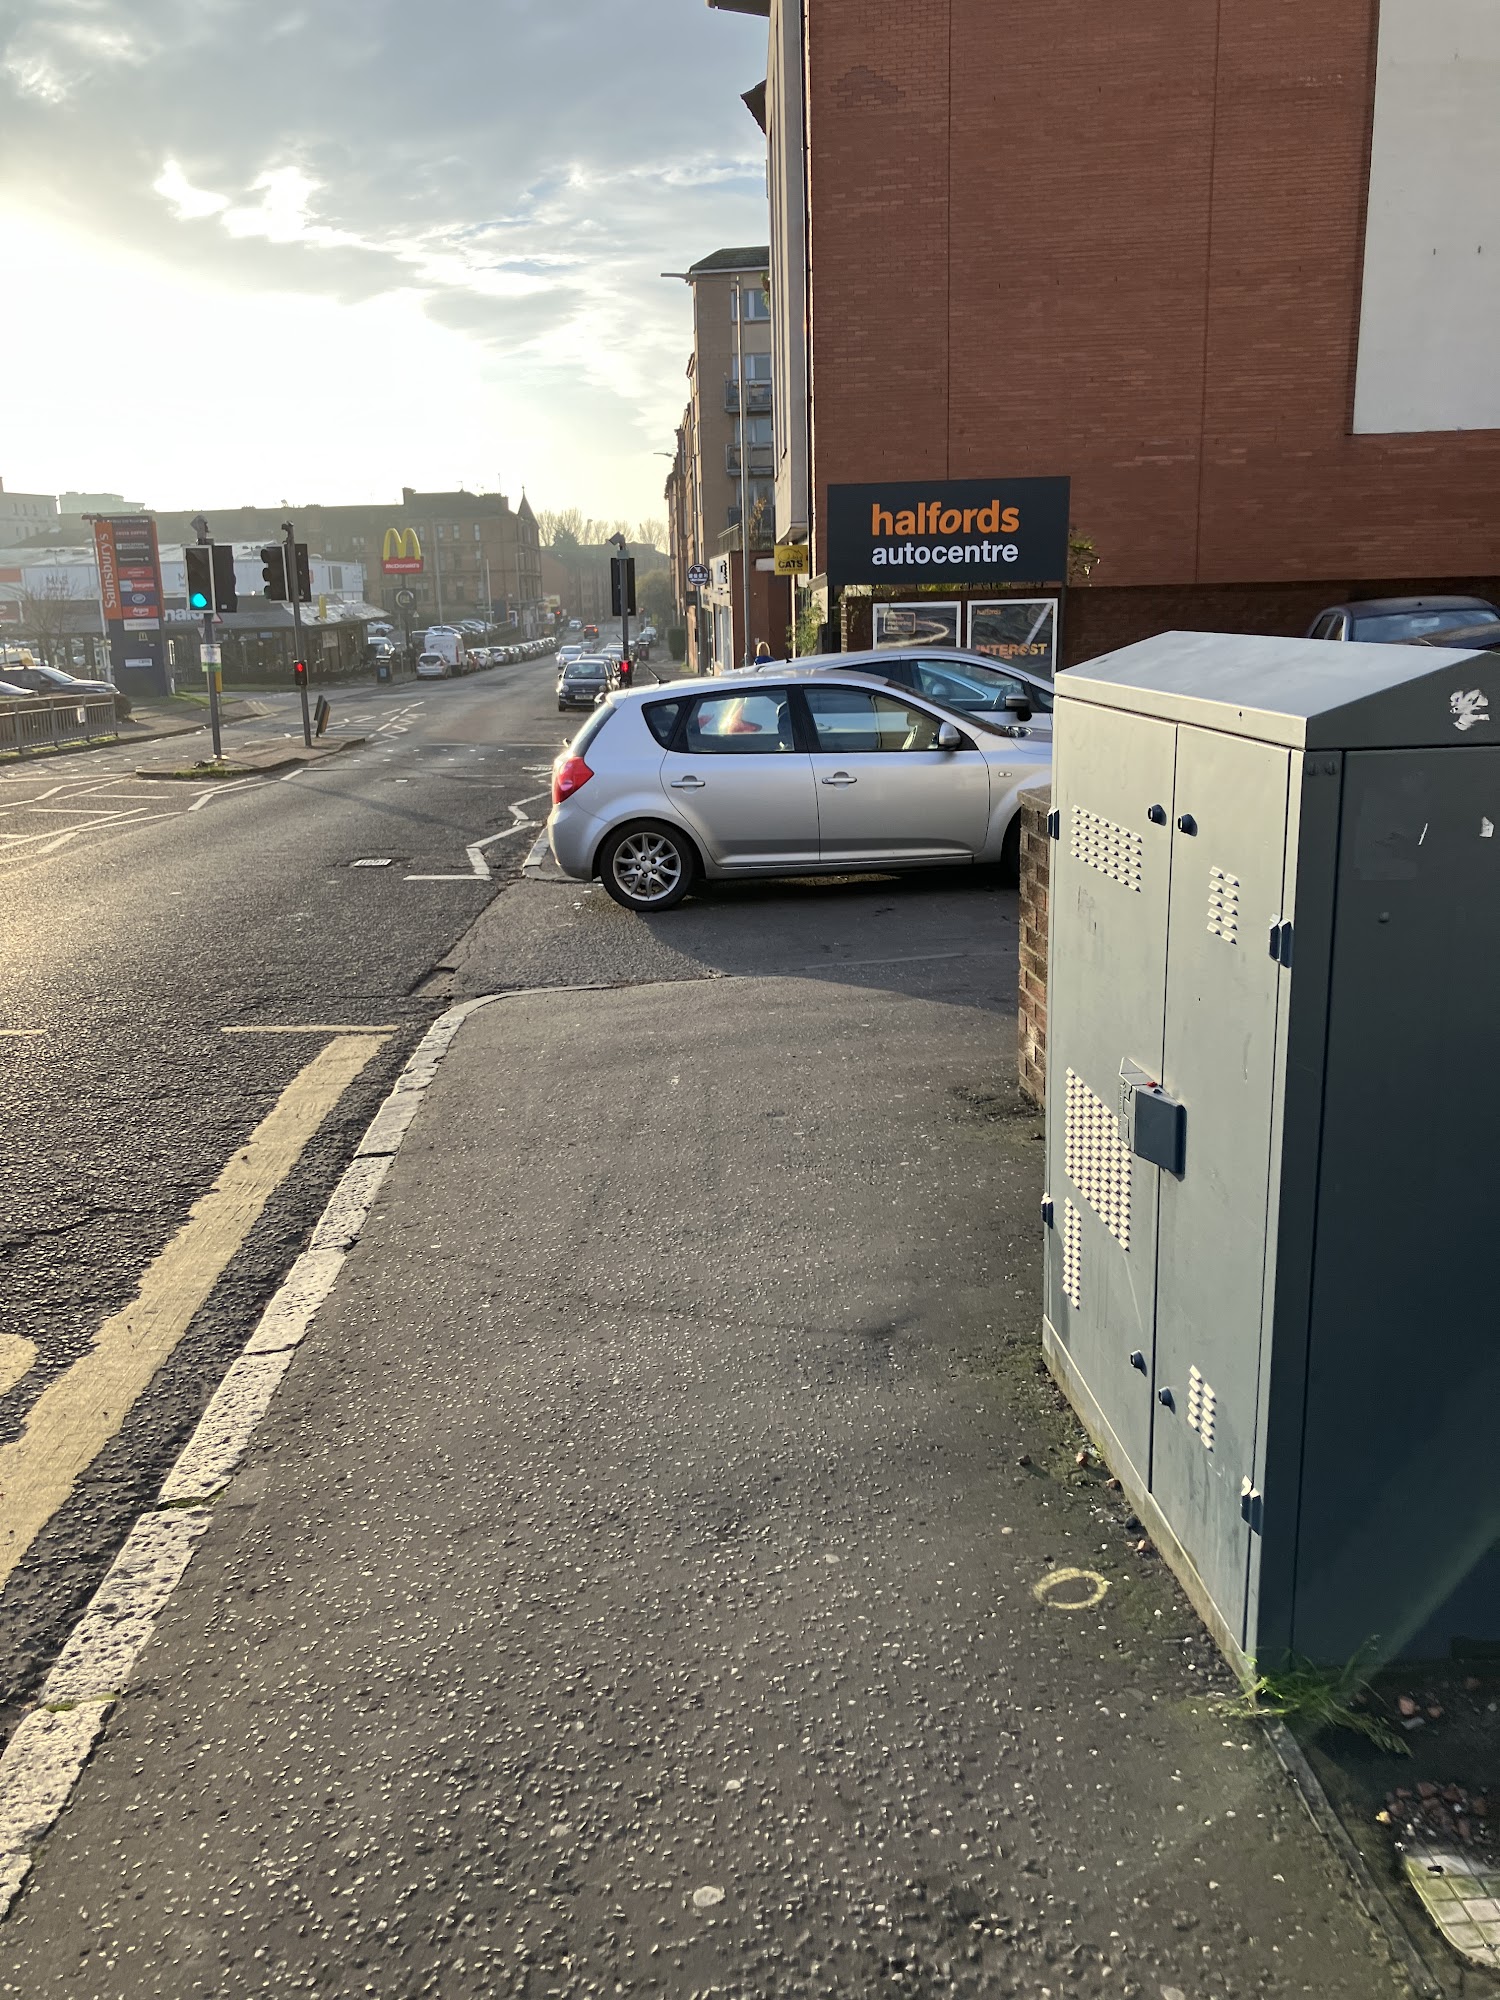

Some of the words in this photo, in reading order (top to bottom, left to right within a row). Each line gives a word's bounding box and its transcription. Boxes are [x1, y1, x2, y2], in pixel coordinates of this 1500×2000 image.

[872, 500, 1020, 536] halfords
[778, 560, 803, 568] CATS
[872, 540, 1018, 565] autocentre
[99, 533, 117, 609] Sainsbury's
[132, 607, 150, 615] Argos
